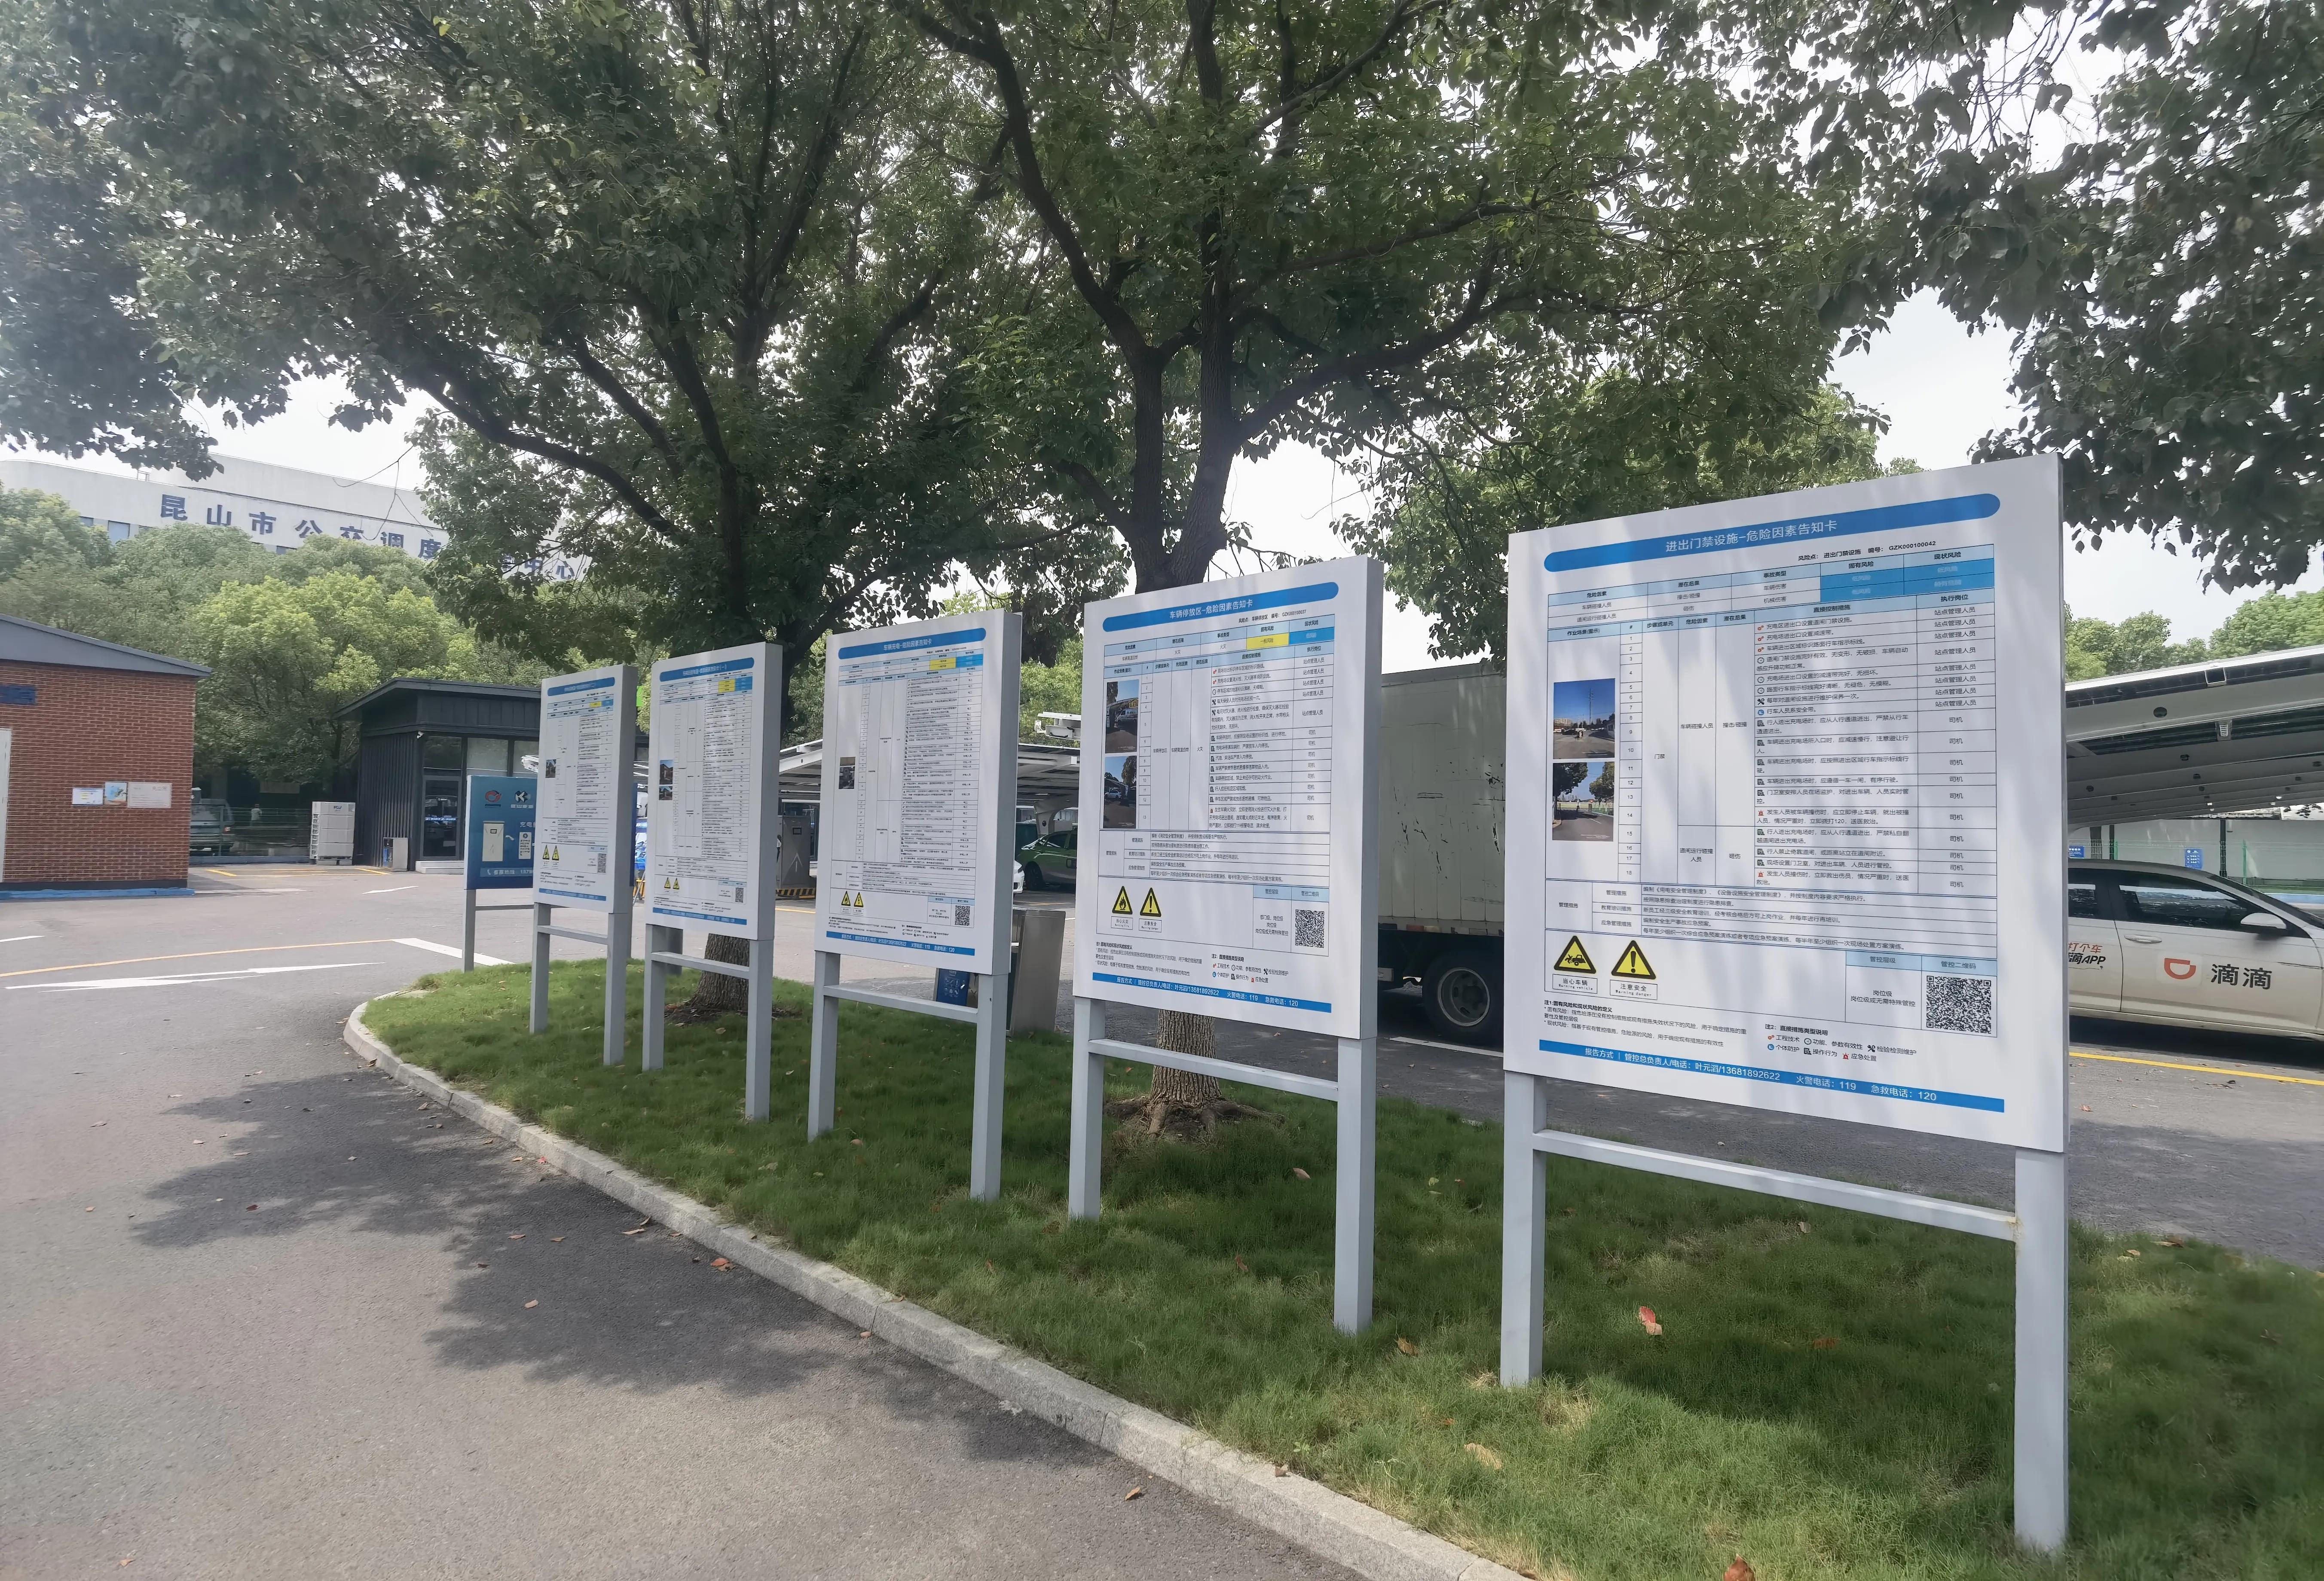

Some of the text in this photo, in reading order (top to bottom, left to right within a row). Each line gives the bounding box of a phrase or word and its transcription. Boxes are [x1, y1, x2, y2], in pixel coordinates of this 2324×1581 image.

[1824, 549, 1861, 559] 进出门禁设施
[1934, 551, 1961, 560] 现状风险
[1941, 594, 1969, 602] 执行岗位
[1934, 606, 1975, 616] 站点管理人员
[1934, 618, 1975, 627] 站点管理人员
[1934, 630, 1976, 639] 站点管理人员
[1935, 646, 1976, 656] 站点管理人员
[1935, 663, 1976, 672] 站点管理人员
[1935, 675, 1976, 684] 站点管理人员
[1935, 687, 1976, 696] 站点管理人员
[1935, 699, 1977, 708] 站点管理人员
[1941, 961, 1976, 969] 管控二维码
[2211, 963, 2272, 990] 滴滴
[1620, 983, 1647, 992] 注意安全
[1585, 1048, 1614, 1059] 报告方式
[1775, 1044, 1800, 1052] 个体防护
[1812, 1048, 1837, 1057] 操作行为
